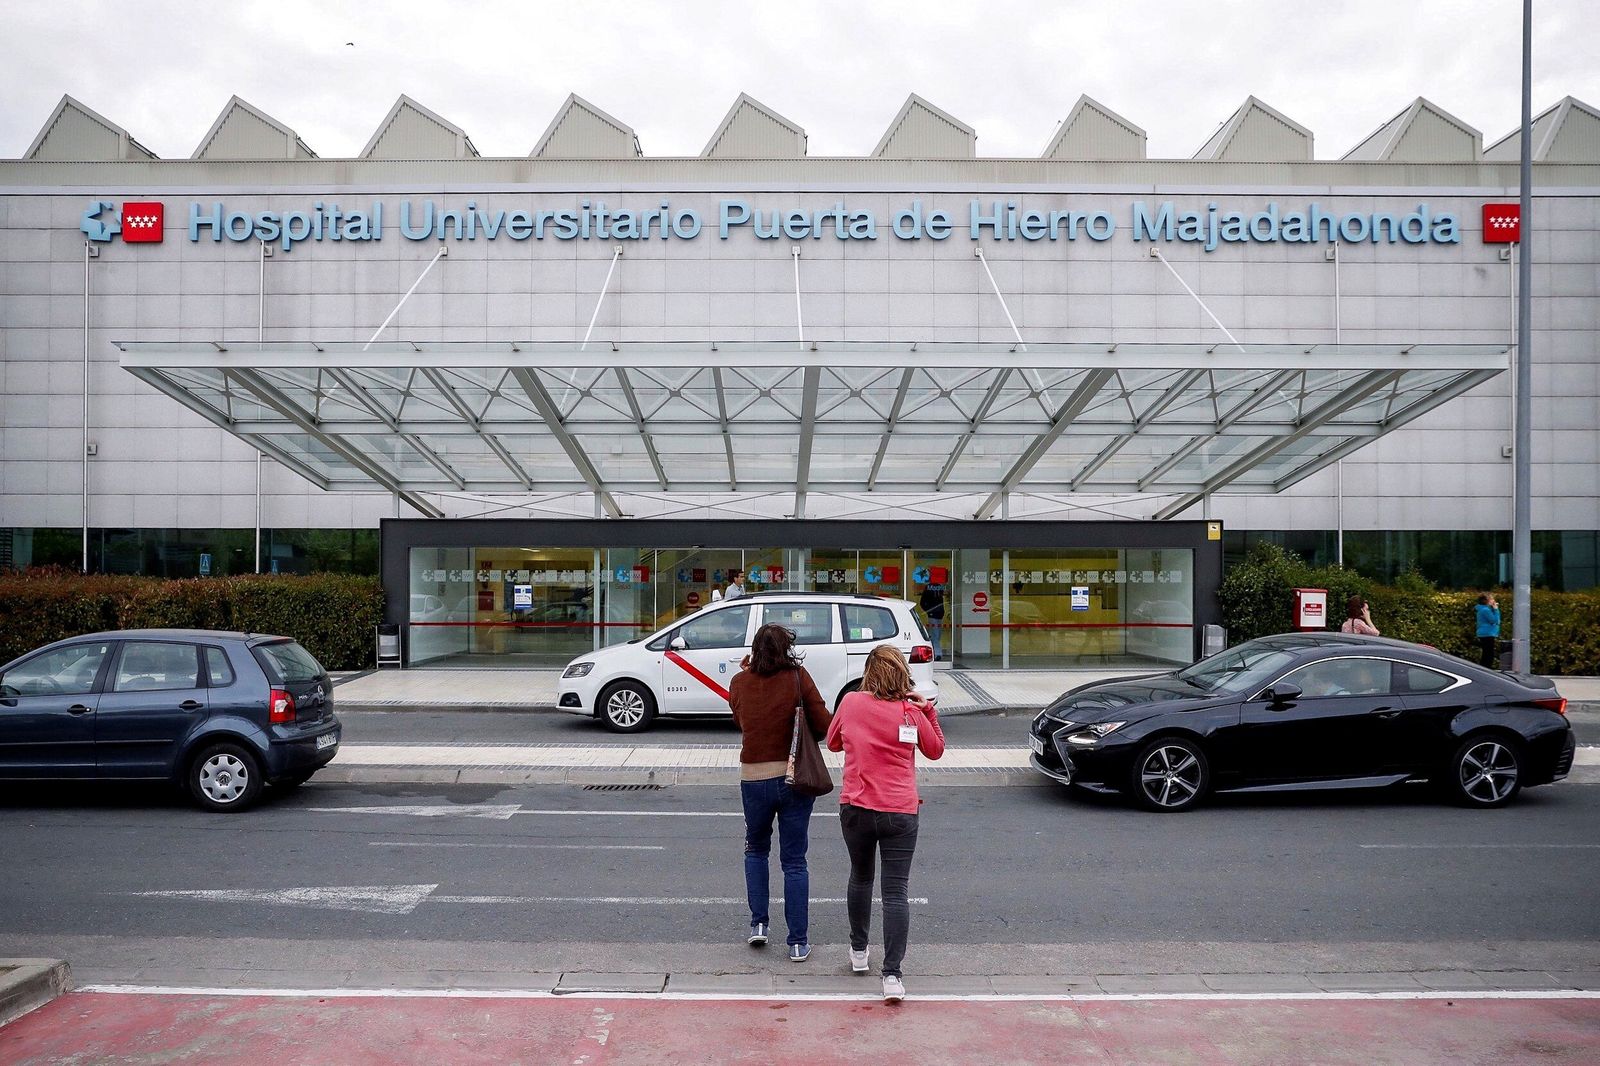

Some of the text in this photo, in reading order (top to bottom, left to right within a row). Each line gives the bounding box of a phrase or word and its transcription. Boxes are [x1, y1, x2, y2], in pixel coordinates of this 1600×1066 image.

[189, 200, 1460, 252] Hospital Universitario Puerta de Hierro Majadahonda
[903, 632, 911, 641] M
